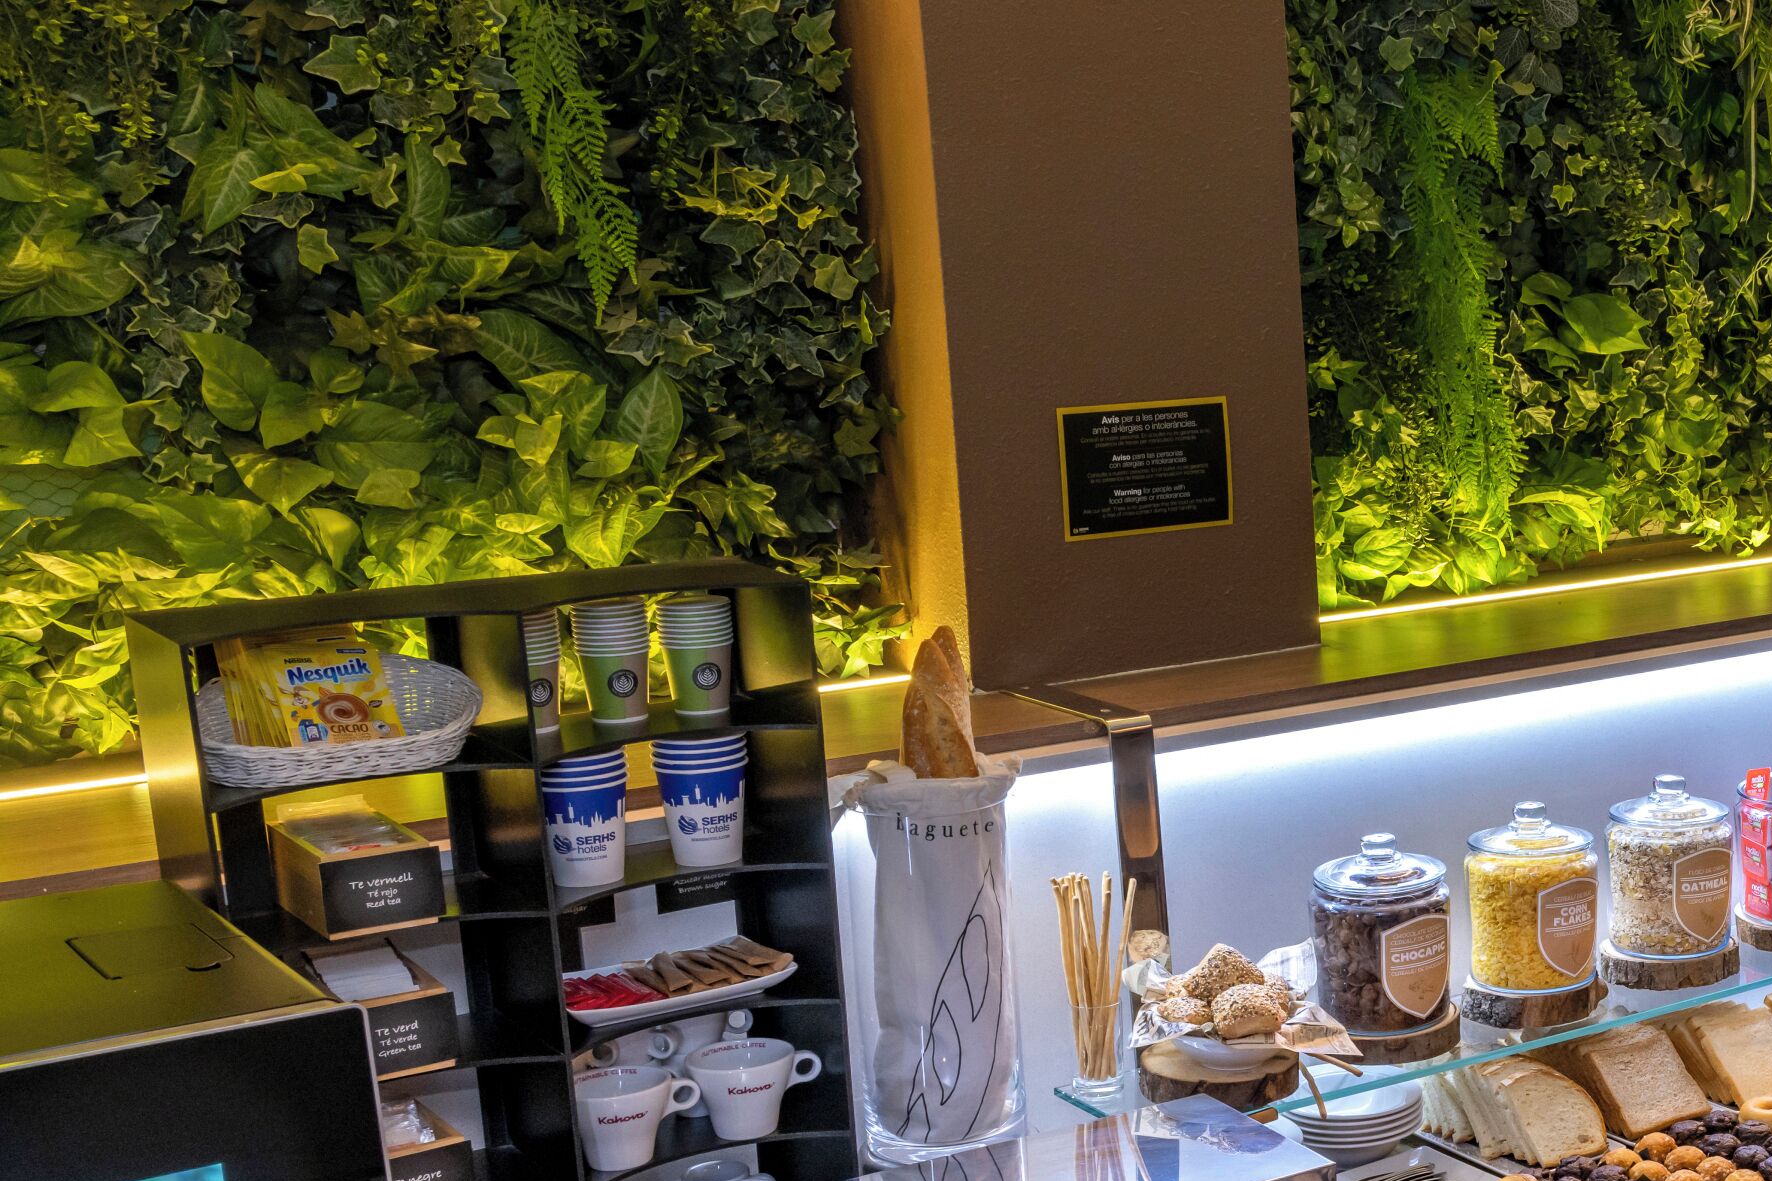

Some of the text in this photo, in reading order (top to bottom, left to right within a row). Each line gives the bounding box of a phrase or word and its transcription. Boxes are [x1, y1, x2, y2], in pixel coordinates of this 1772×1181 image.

[1112, 454, 1131, 462] Aviso
[1113, 488, 1142, 497] Warning
[286, 657, 372, 686] Nesquik
[330, 723, 369, 734] CACAO
[701, 811, 738, 826] SERHS
[702, 823, 731, 835] hotels
[576, 831, 616, 846] SERHS
[577, 843, 608, 855] hotels
[348, 872, 414, 890] Te vermell
[678, 880, 728, 894] Brown sugar
[1681, 876, 1728, 893] OATMEAL
[380, 888, 398, 898] rojo
[366, 897, 401, 909] Red tea
[1560, 903, 1588, 916] CORN
[1553, 911, 1591, 927] FLAKES
[1391, 940, 1446, 963] CHOCAPIC
[374, 1020, 419, 1037] Te verd
[393, 1033, 418, 1045] verde
[378, 1042, 422, 1058] Green tea
[727, 1081, 776, 1097] Kahova
[597, 1110, 649, 1126] Kahova
